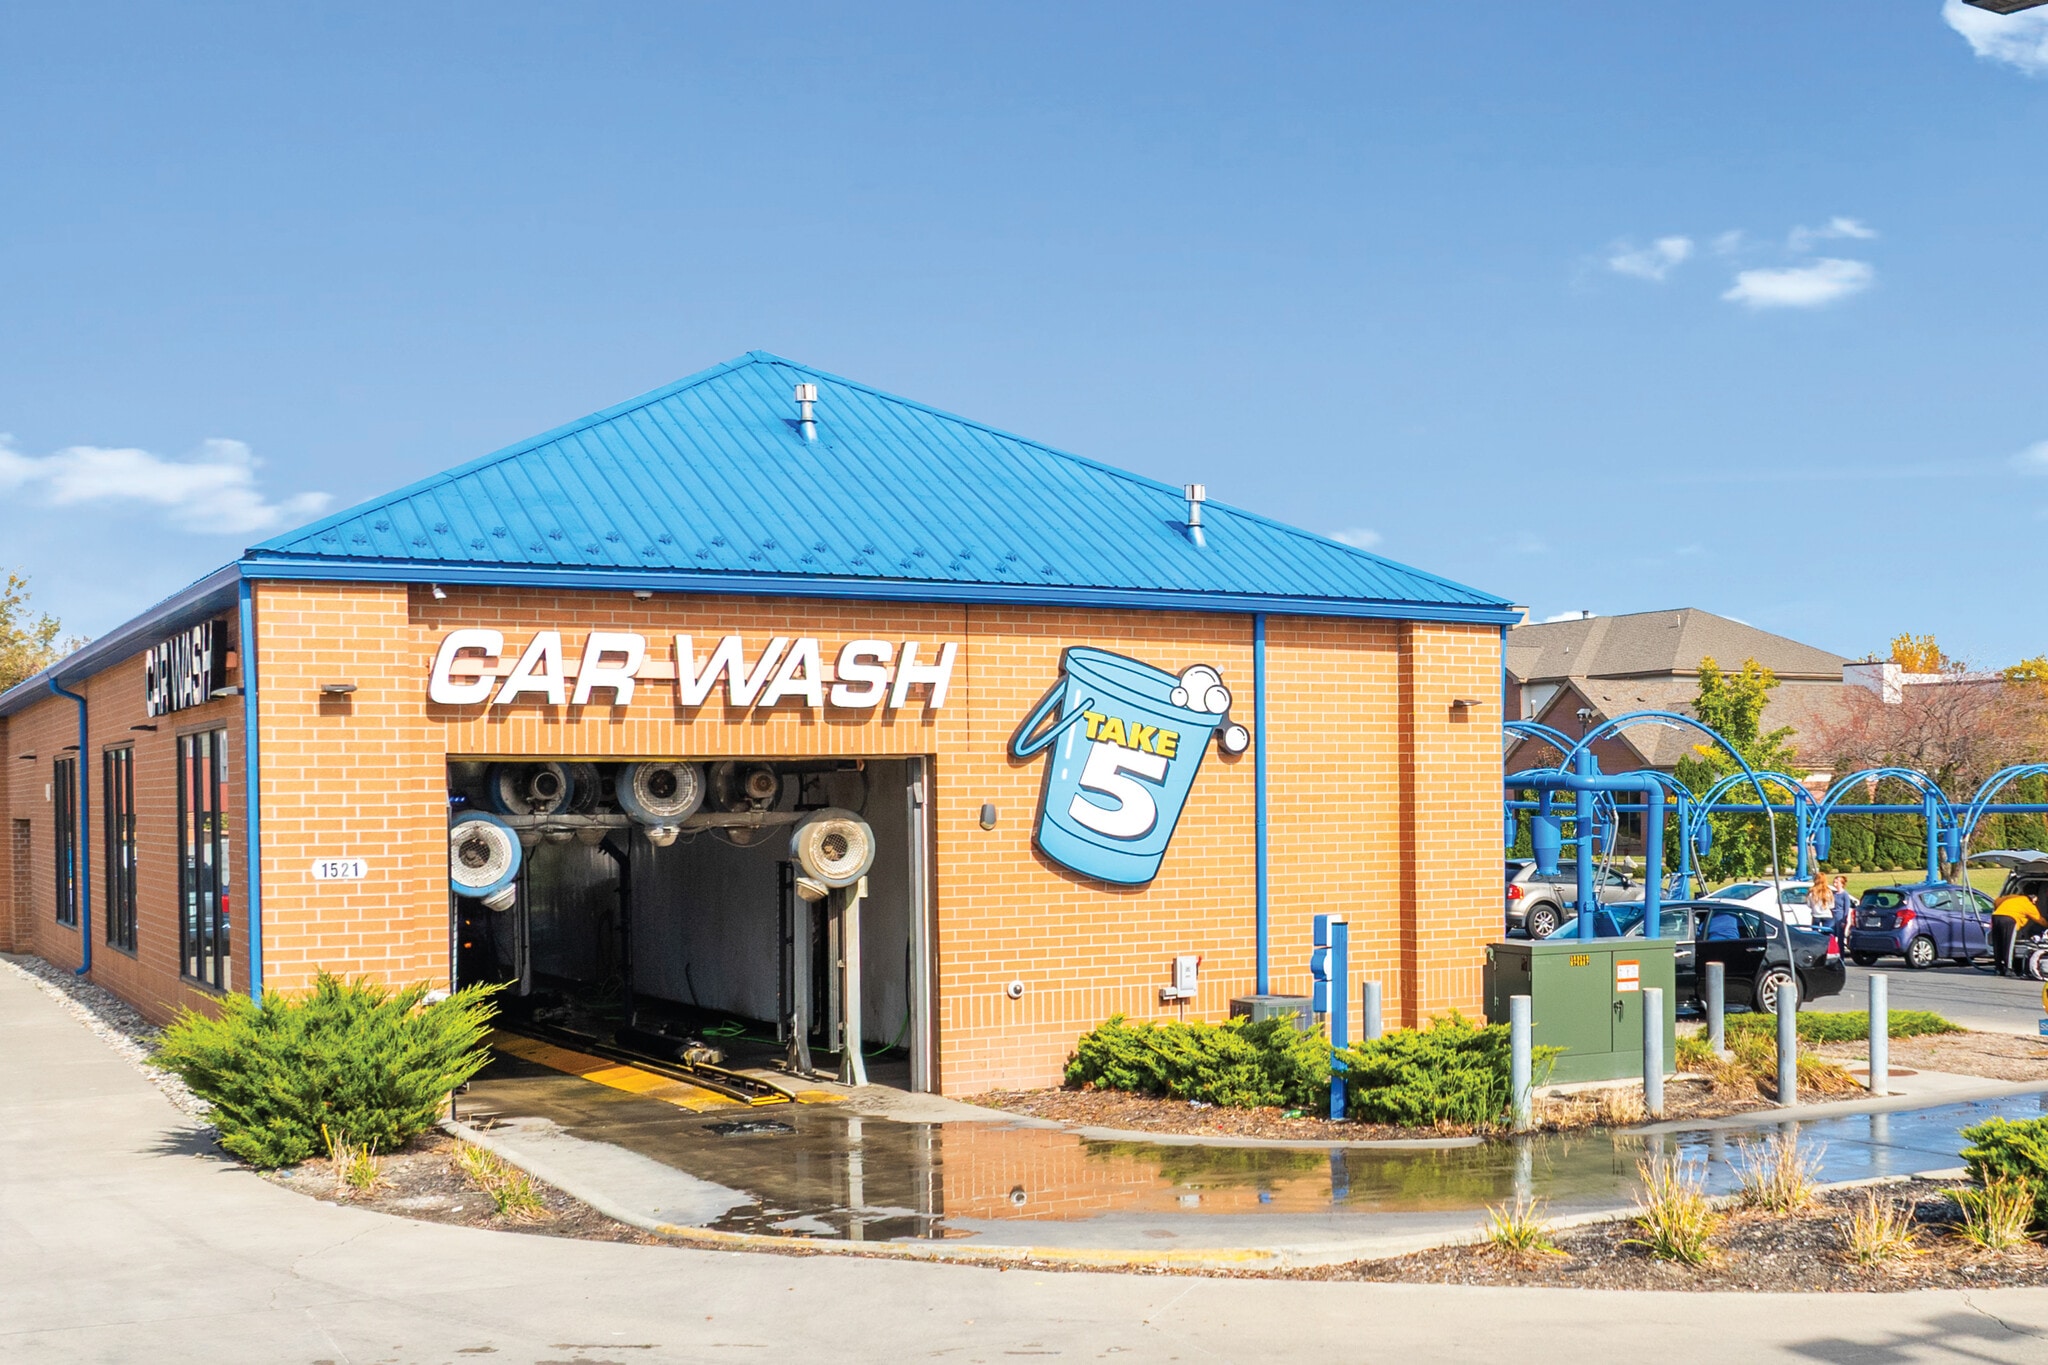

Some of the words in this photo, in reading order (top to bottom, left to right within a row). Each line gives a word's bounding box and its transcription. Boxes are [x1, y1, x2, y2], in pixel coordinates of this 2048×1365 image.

[145, 642, 169, 717] CAR
[169, 621, 212, 711] WASH
[428, 629, 645, 705] CAR
[673, 634, 958, 709] WASH
[1083, 710, 1180, 760] TAKE
[1068, 744, 1169, 841] 5
[321, 862, 359, 878] 1521
